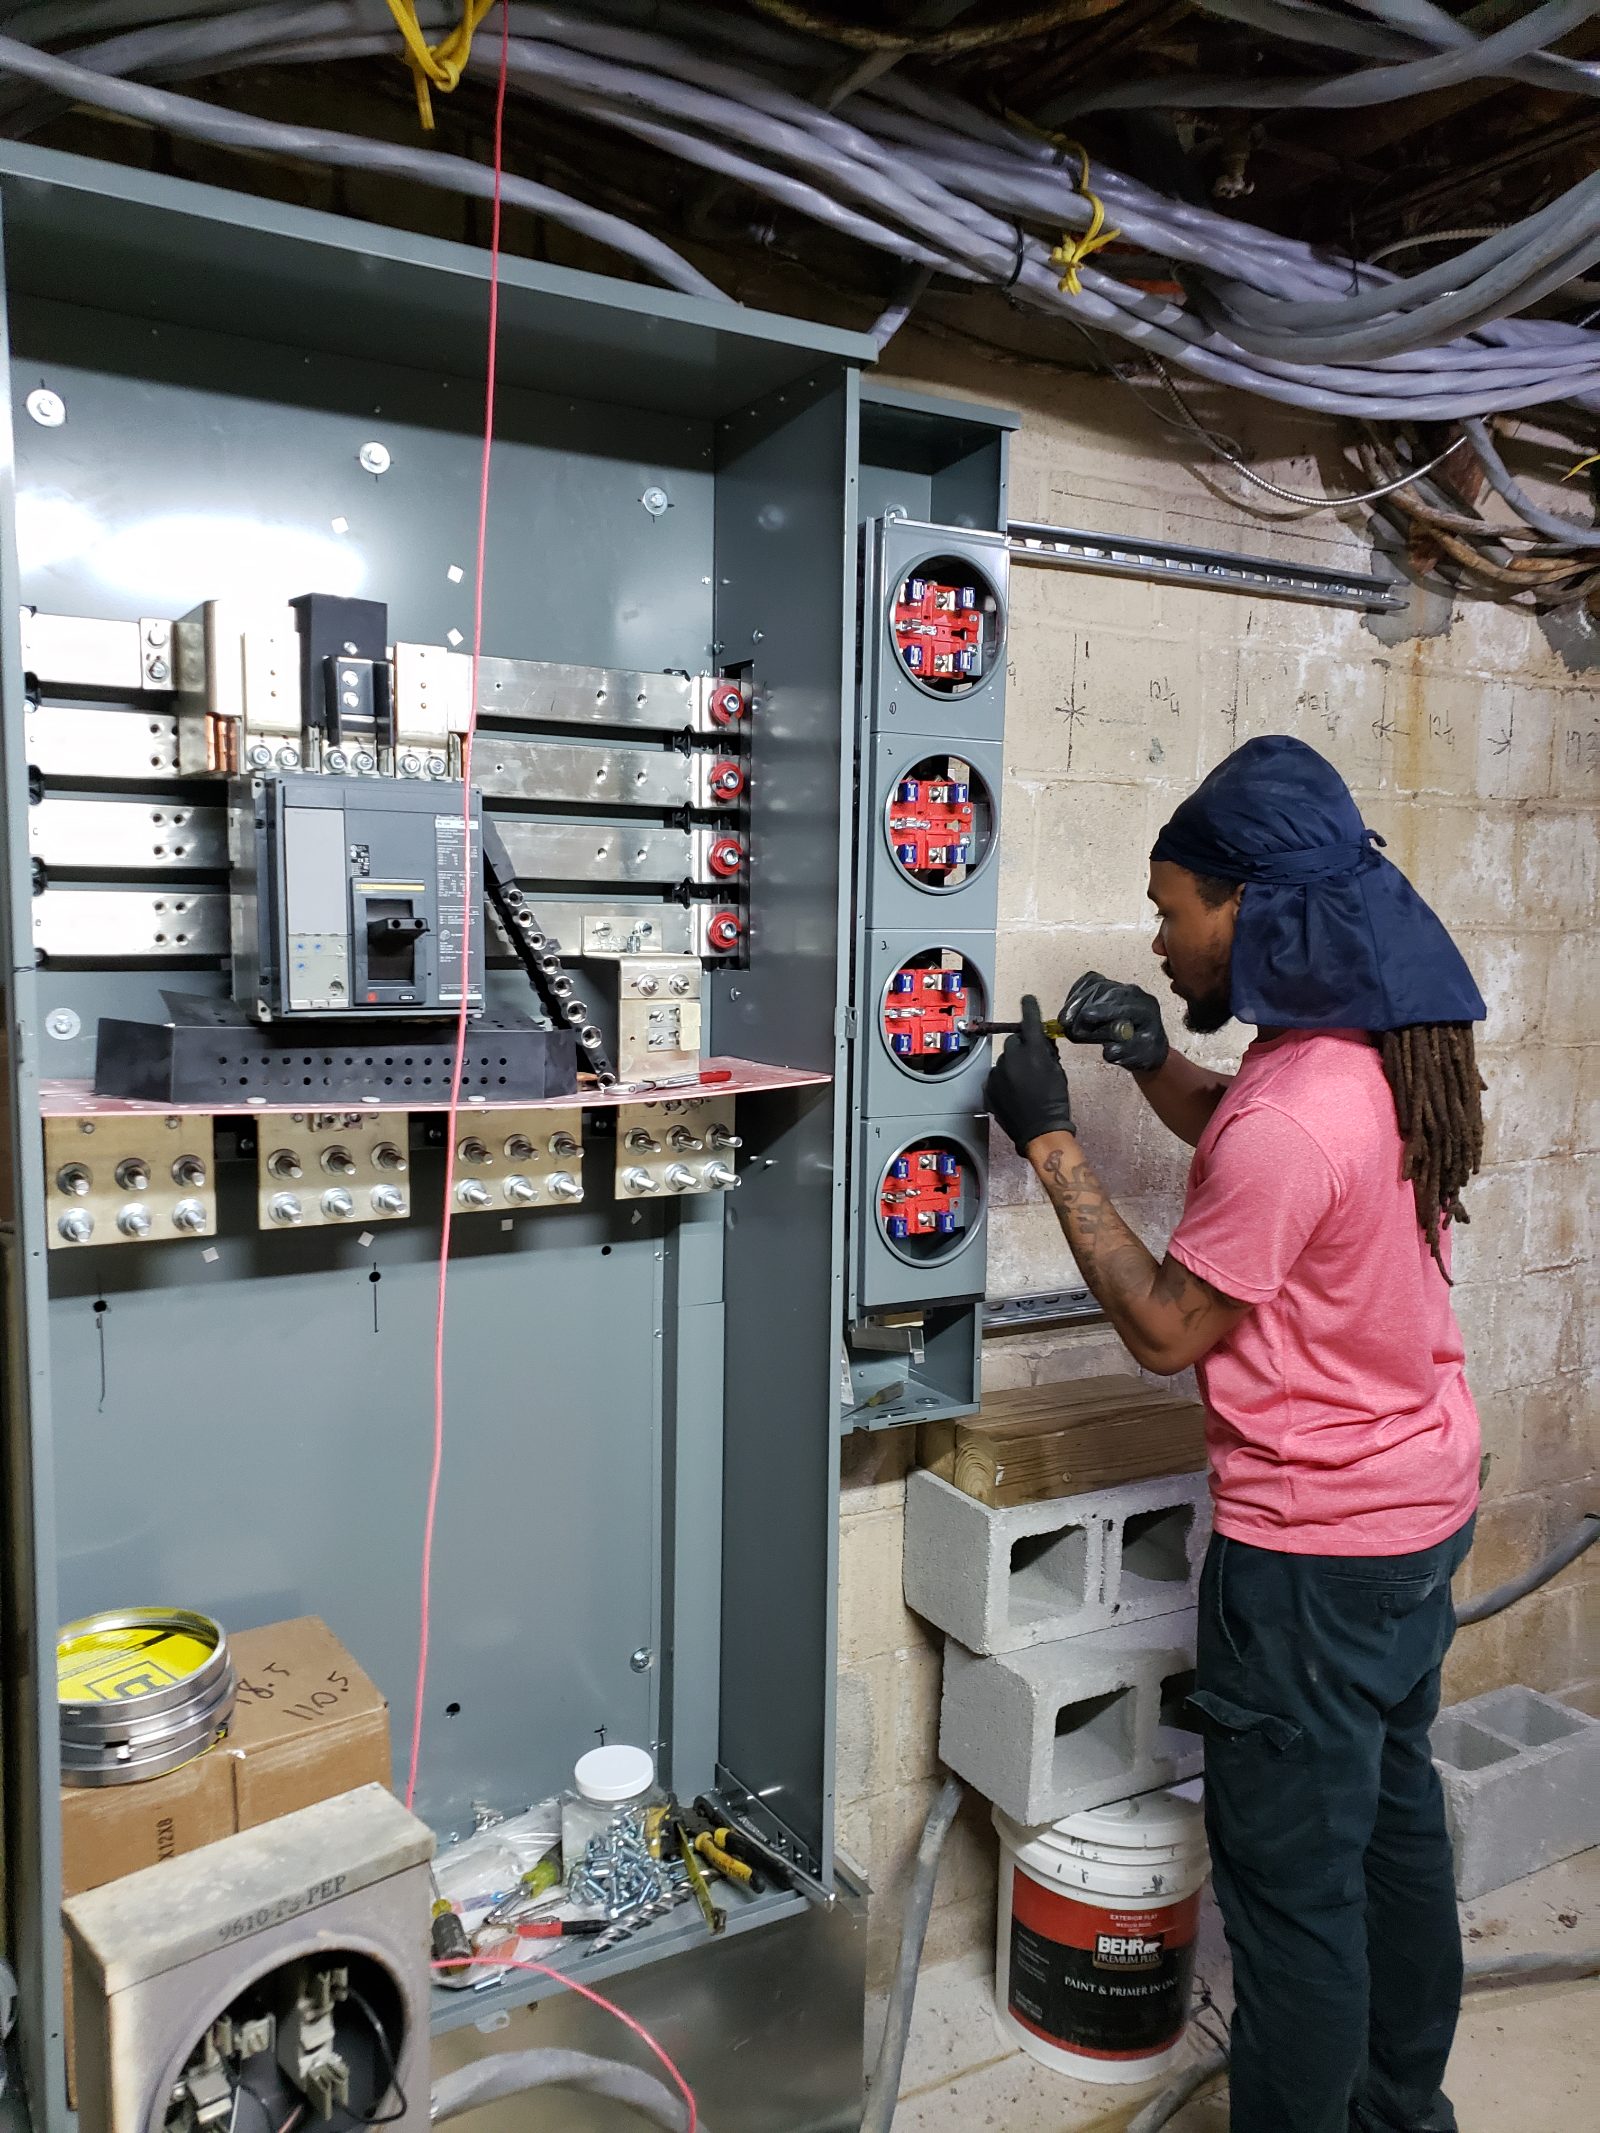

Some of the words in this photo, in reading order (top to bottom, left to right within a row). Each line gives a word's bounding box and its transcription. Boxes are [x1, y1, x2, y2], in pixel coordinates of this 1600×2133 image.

[1098, 1936, 1145, 1956] BEHR
[1097, 1953, 1139, 1964] PREMIUM
[1140, 1954, 1160, 1964] PLUS
[1064, 1976, 1096, 1993] PAINT
[1098, 1985, 1108, 1995] &
[1109, 1986, 1148, 1997] PRIMER
[1150, 1984, 1161, 1994] IN
